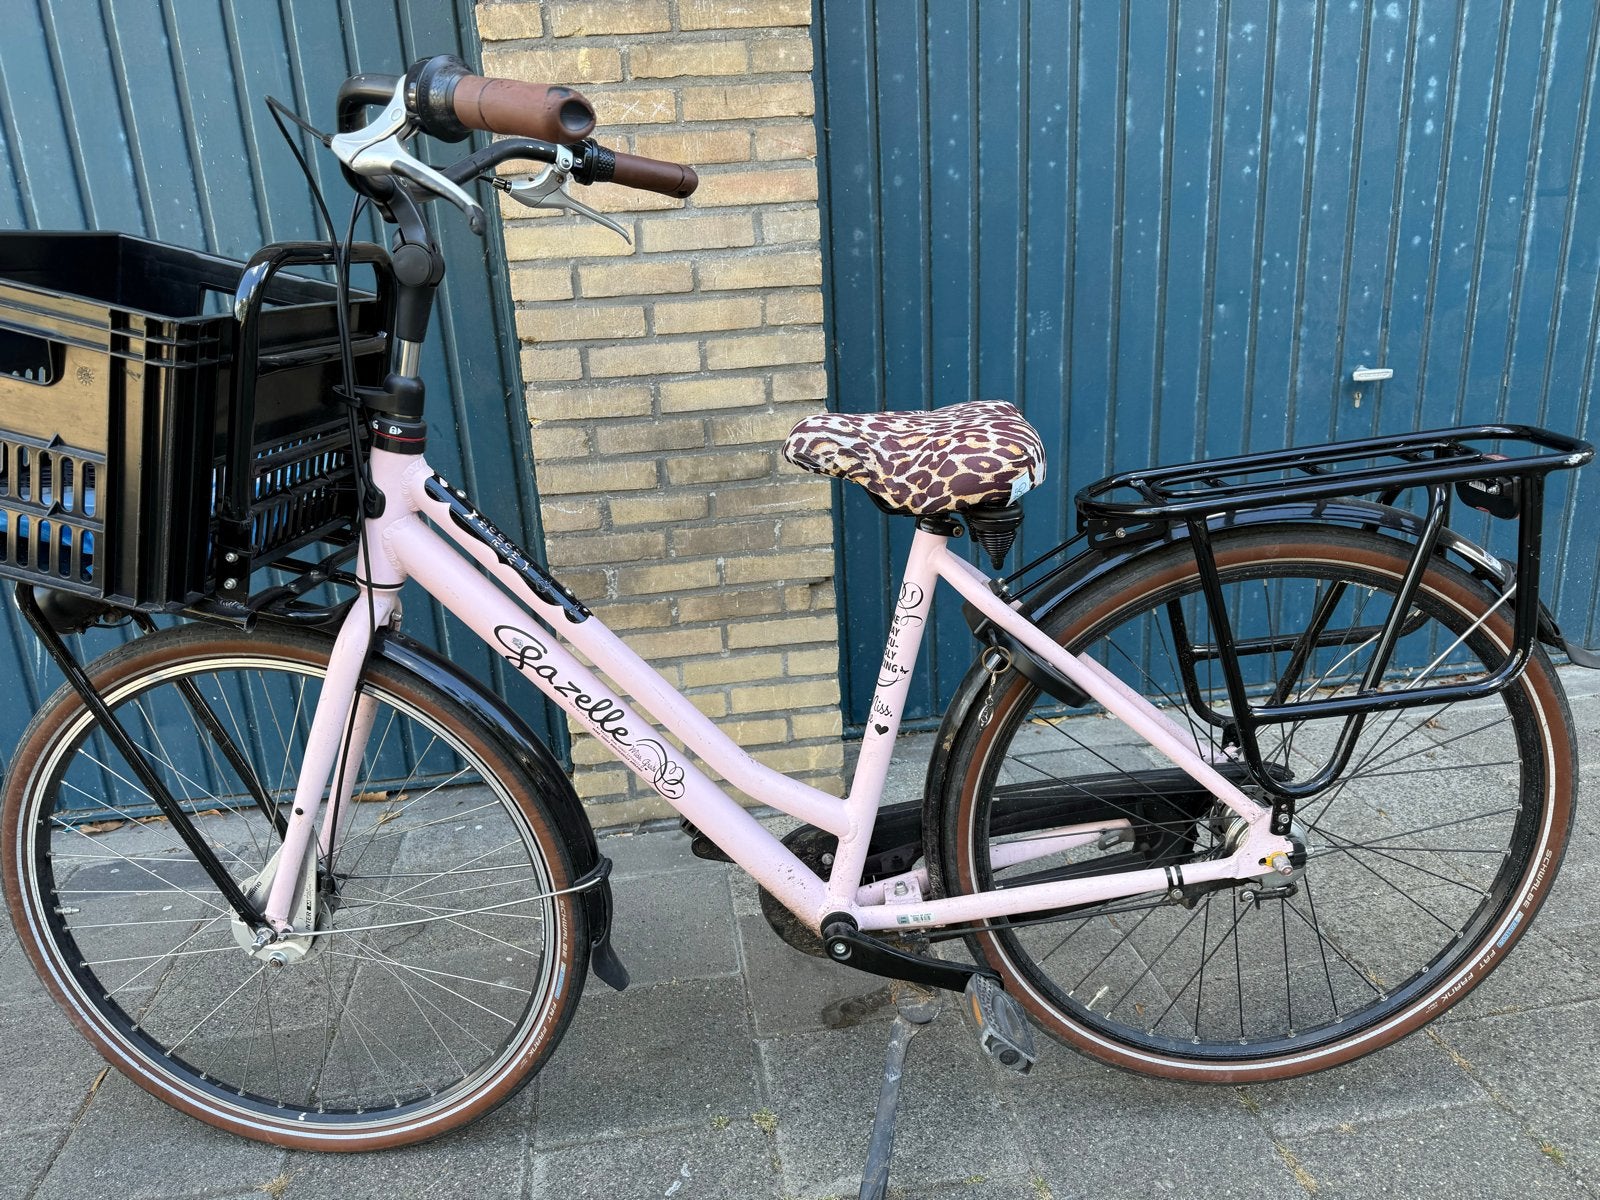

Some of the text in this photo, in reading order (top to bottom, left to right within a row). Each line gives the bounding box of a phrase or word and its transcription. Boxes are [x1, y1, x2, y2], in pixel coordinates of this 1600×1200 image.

[493, 624, 632, 746] Gazelle
[1525, 849, 1553, 909] SCHWALBE
[559, 899, 568, 960] SCHWALBE
[1479, 949, 1496, 970] FAT
[548, 1001, 557, 1023] FAT
